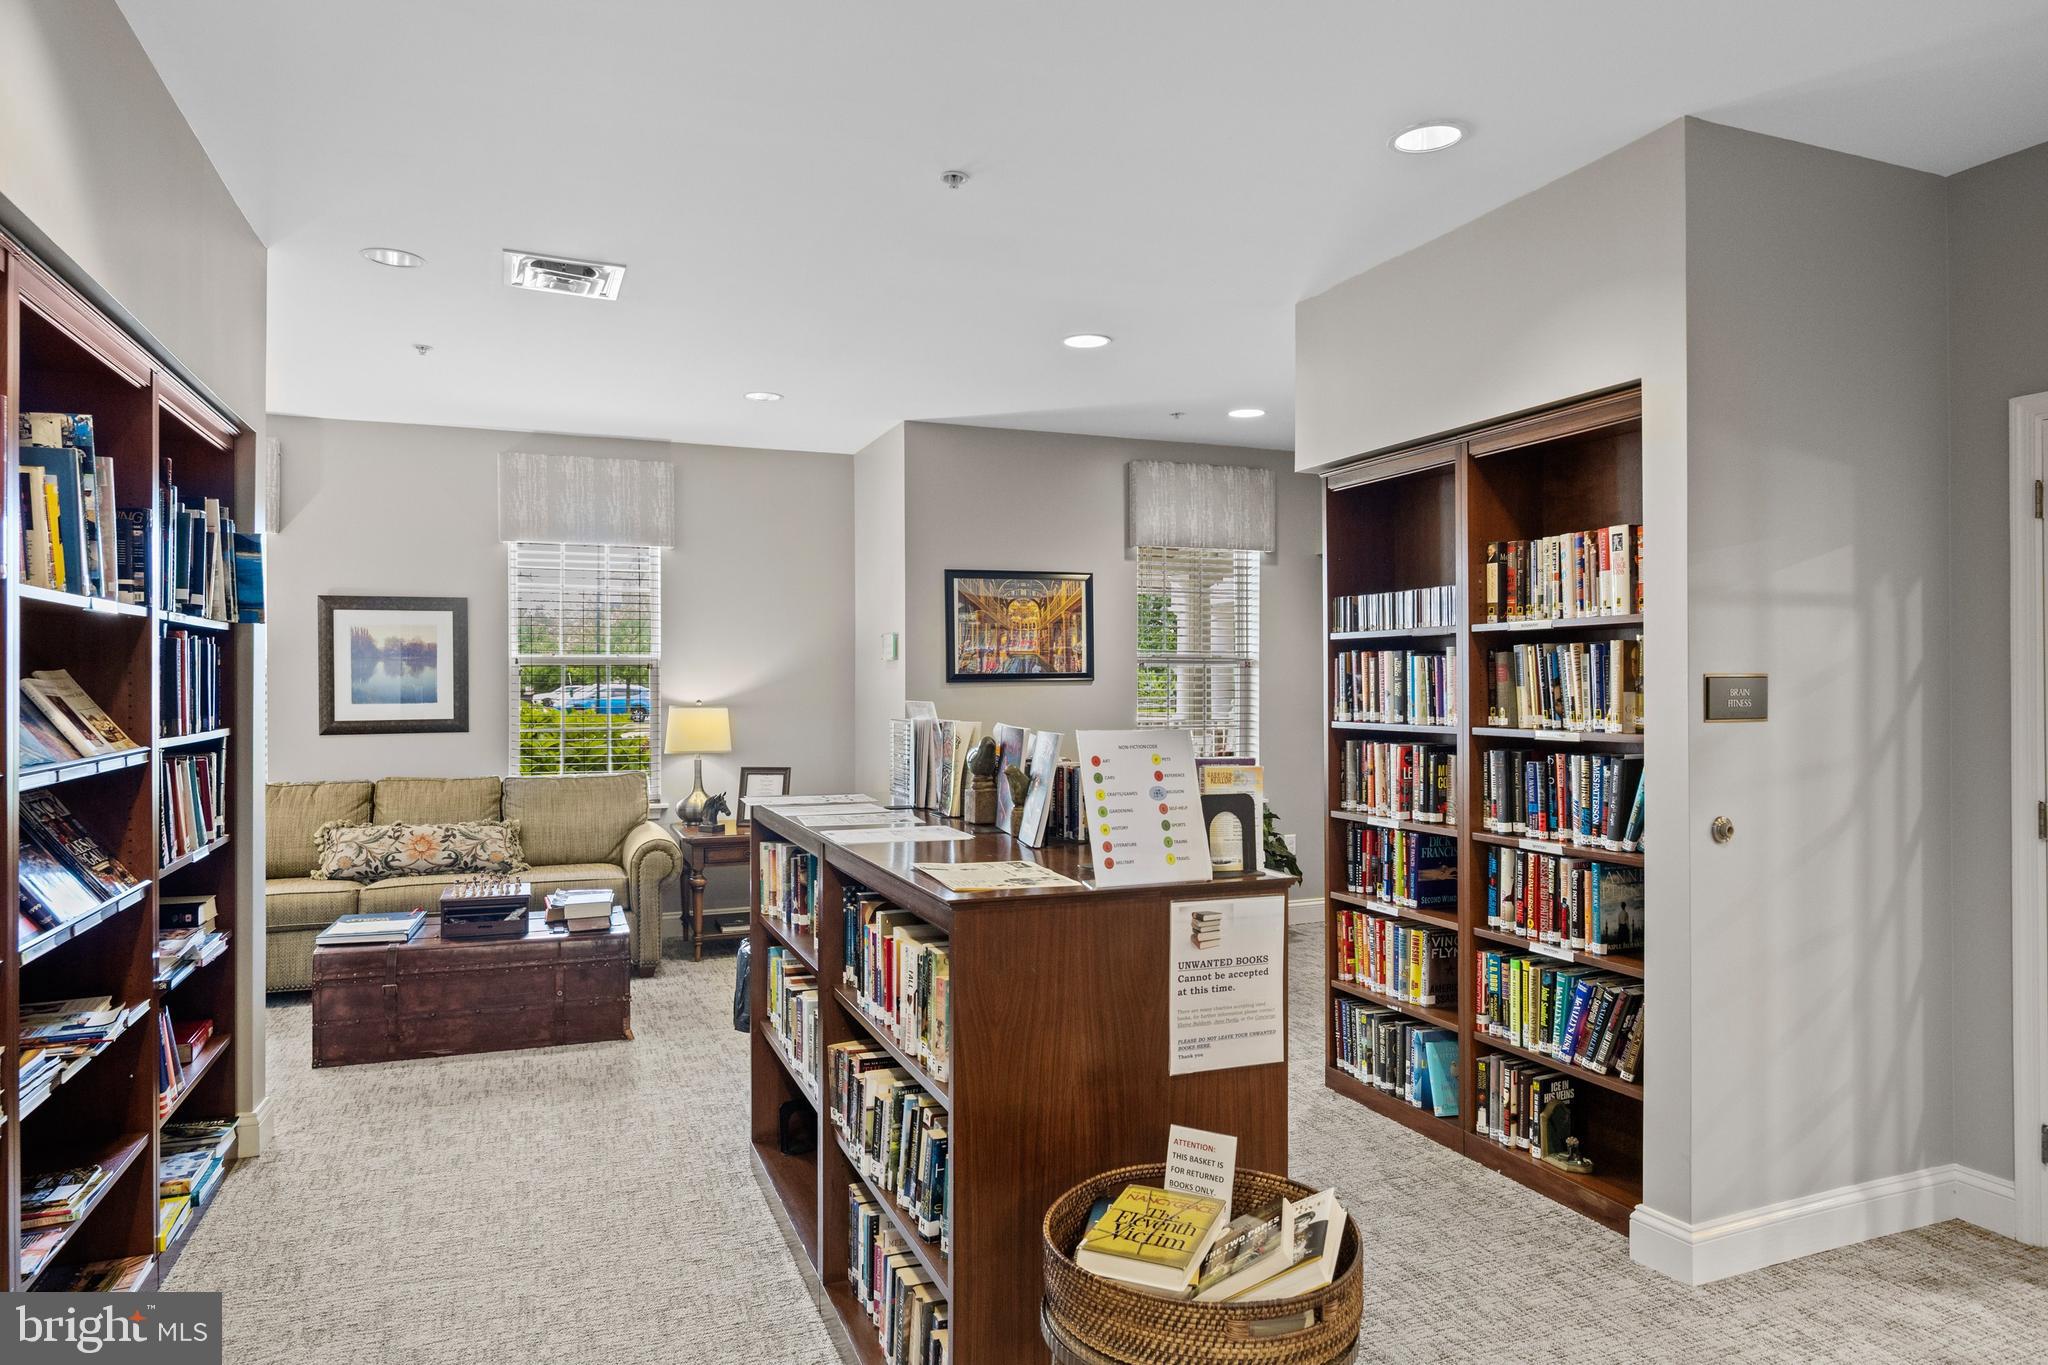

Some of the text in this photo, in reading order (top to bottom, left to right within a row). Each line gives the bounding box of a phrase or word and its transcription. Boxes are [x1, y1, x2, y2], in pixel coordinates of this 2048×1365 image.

[1729, 688, 1750, 697] BRAIN
[1210, 777, 1232, 785] KEILLOR
[1592, 782, 1601, 825] PATTERSON
[1527, 878, 1535, 918] PATTERSON
[1411, 934, 1420, 965] LONGSHOT
[1177, 955, 1269, 971] UNWANTED BOOKS
[1489, 959, 1498, 967] J.
[1177, 967, 1270, 983] Cannot be accepted
[1489, 973, 1498, 992] ROBB
[1177, 984, 1236, 997] at this time.
[1540, 985, 1550, 1027] John Sandford
[1554, 986, 1564, 1025] McNALLY'S
[1587, 998, 1601, 1023] SANDFORD
[1562, 996, 1583, 1053] McNALLY'S RISK
[1594, 1000, 1609, 1031] McNALLY'S
[1177, 1037, 1197, 1045] PLEASE
[1249, 1029, 1277, 1038] UNWANTED
[937, 1065, 942, 1074] F
[1550, 1079, 1569, 1092] ICE IN
[1543, 1088, 1575, 1104] HIS VEINS
[1172, 1137, 1217, 1154] ATTENTION:
[1172, 1152, 1225, 1169] THIS BASKET IS
[1169, 1165, 1225, 1184] FOR RETURNED
[1168, 1179, 1217, 1197] BOOKS ONLY.
[1125, 1191, 1218, 1215] NANCY GRACE
[1113, 1209, 1198, 1237] Eleventh
[1146, 1206, 1181, 1223] The
[920, 1219, 925, 1231] H
[1224, 1234, 1246, 1251] TWO
[1247, 1215, 1280, 1236] POPES
[1110, 1219, 1187, 1252] Victim
